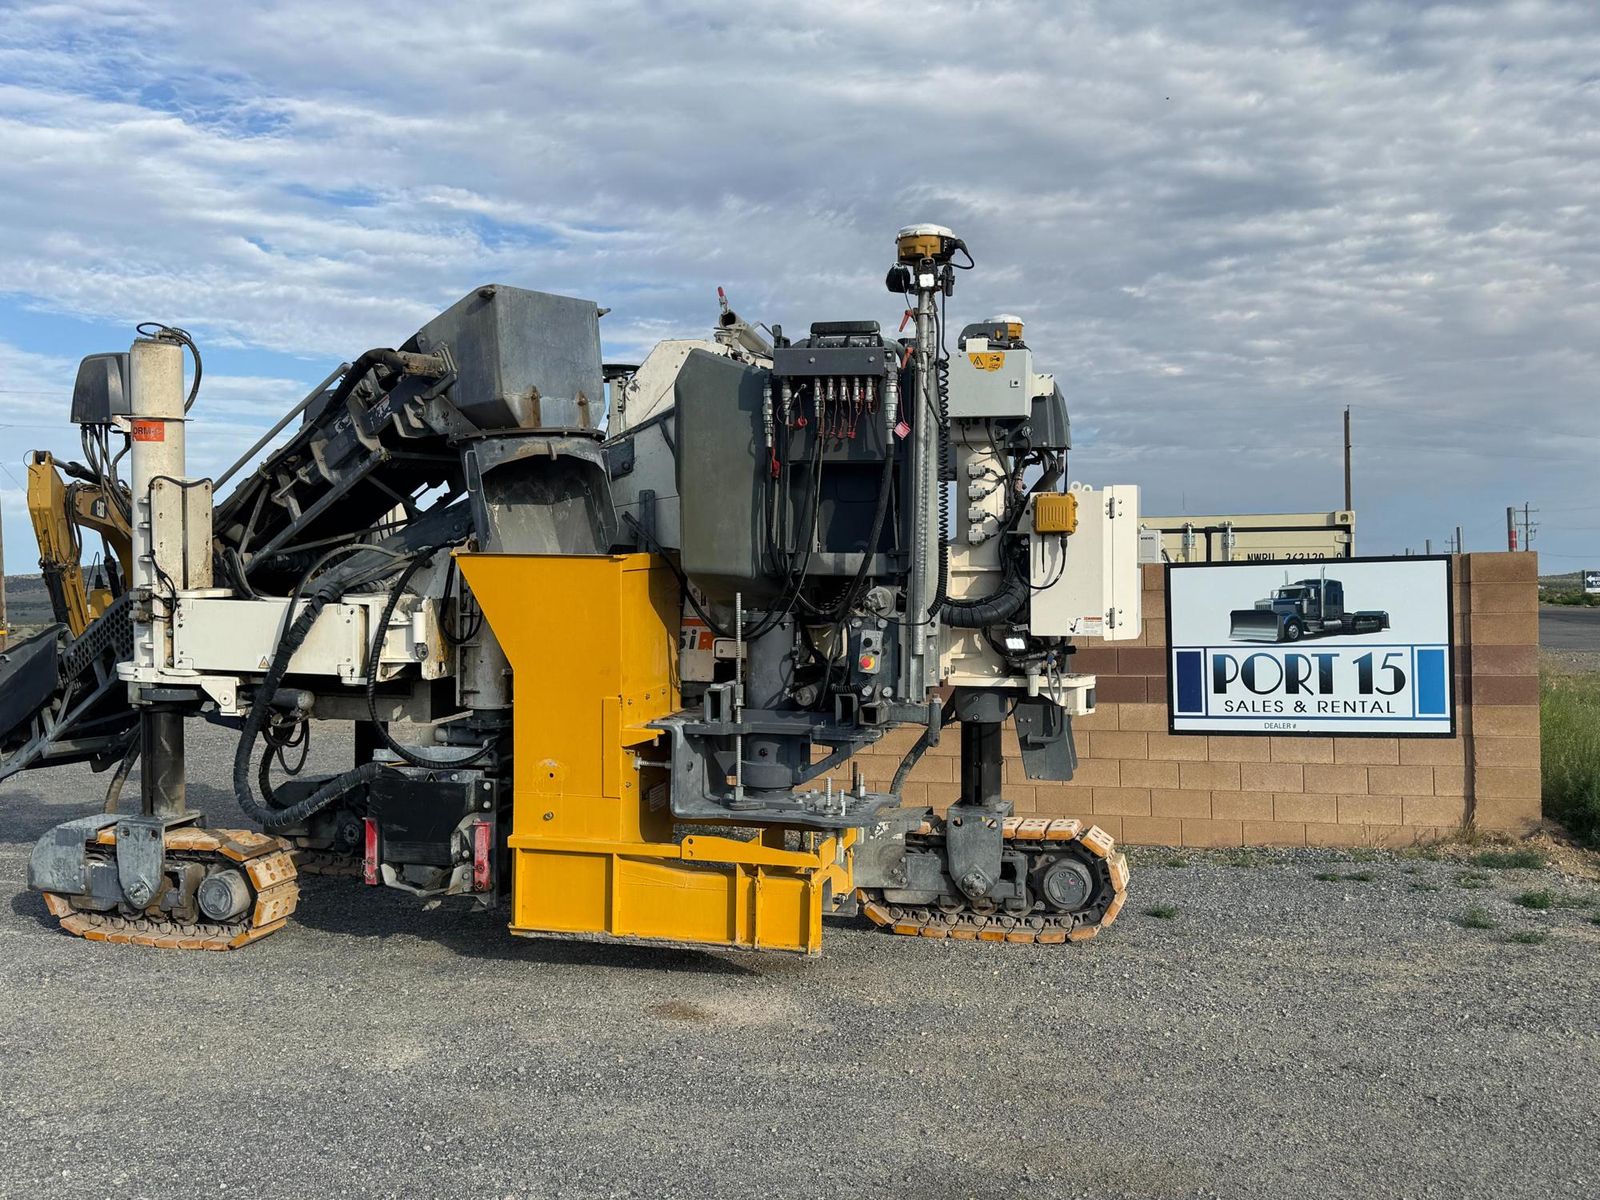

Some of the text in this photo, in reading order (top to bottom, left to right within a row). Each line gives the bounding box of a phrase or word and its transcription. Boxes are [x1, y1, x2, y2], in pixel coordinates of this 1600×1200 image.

[1212, 652, 1406, 696] PORT 15
[1224, 700, 1396, 714] SALES & RENTAL
